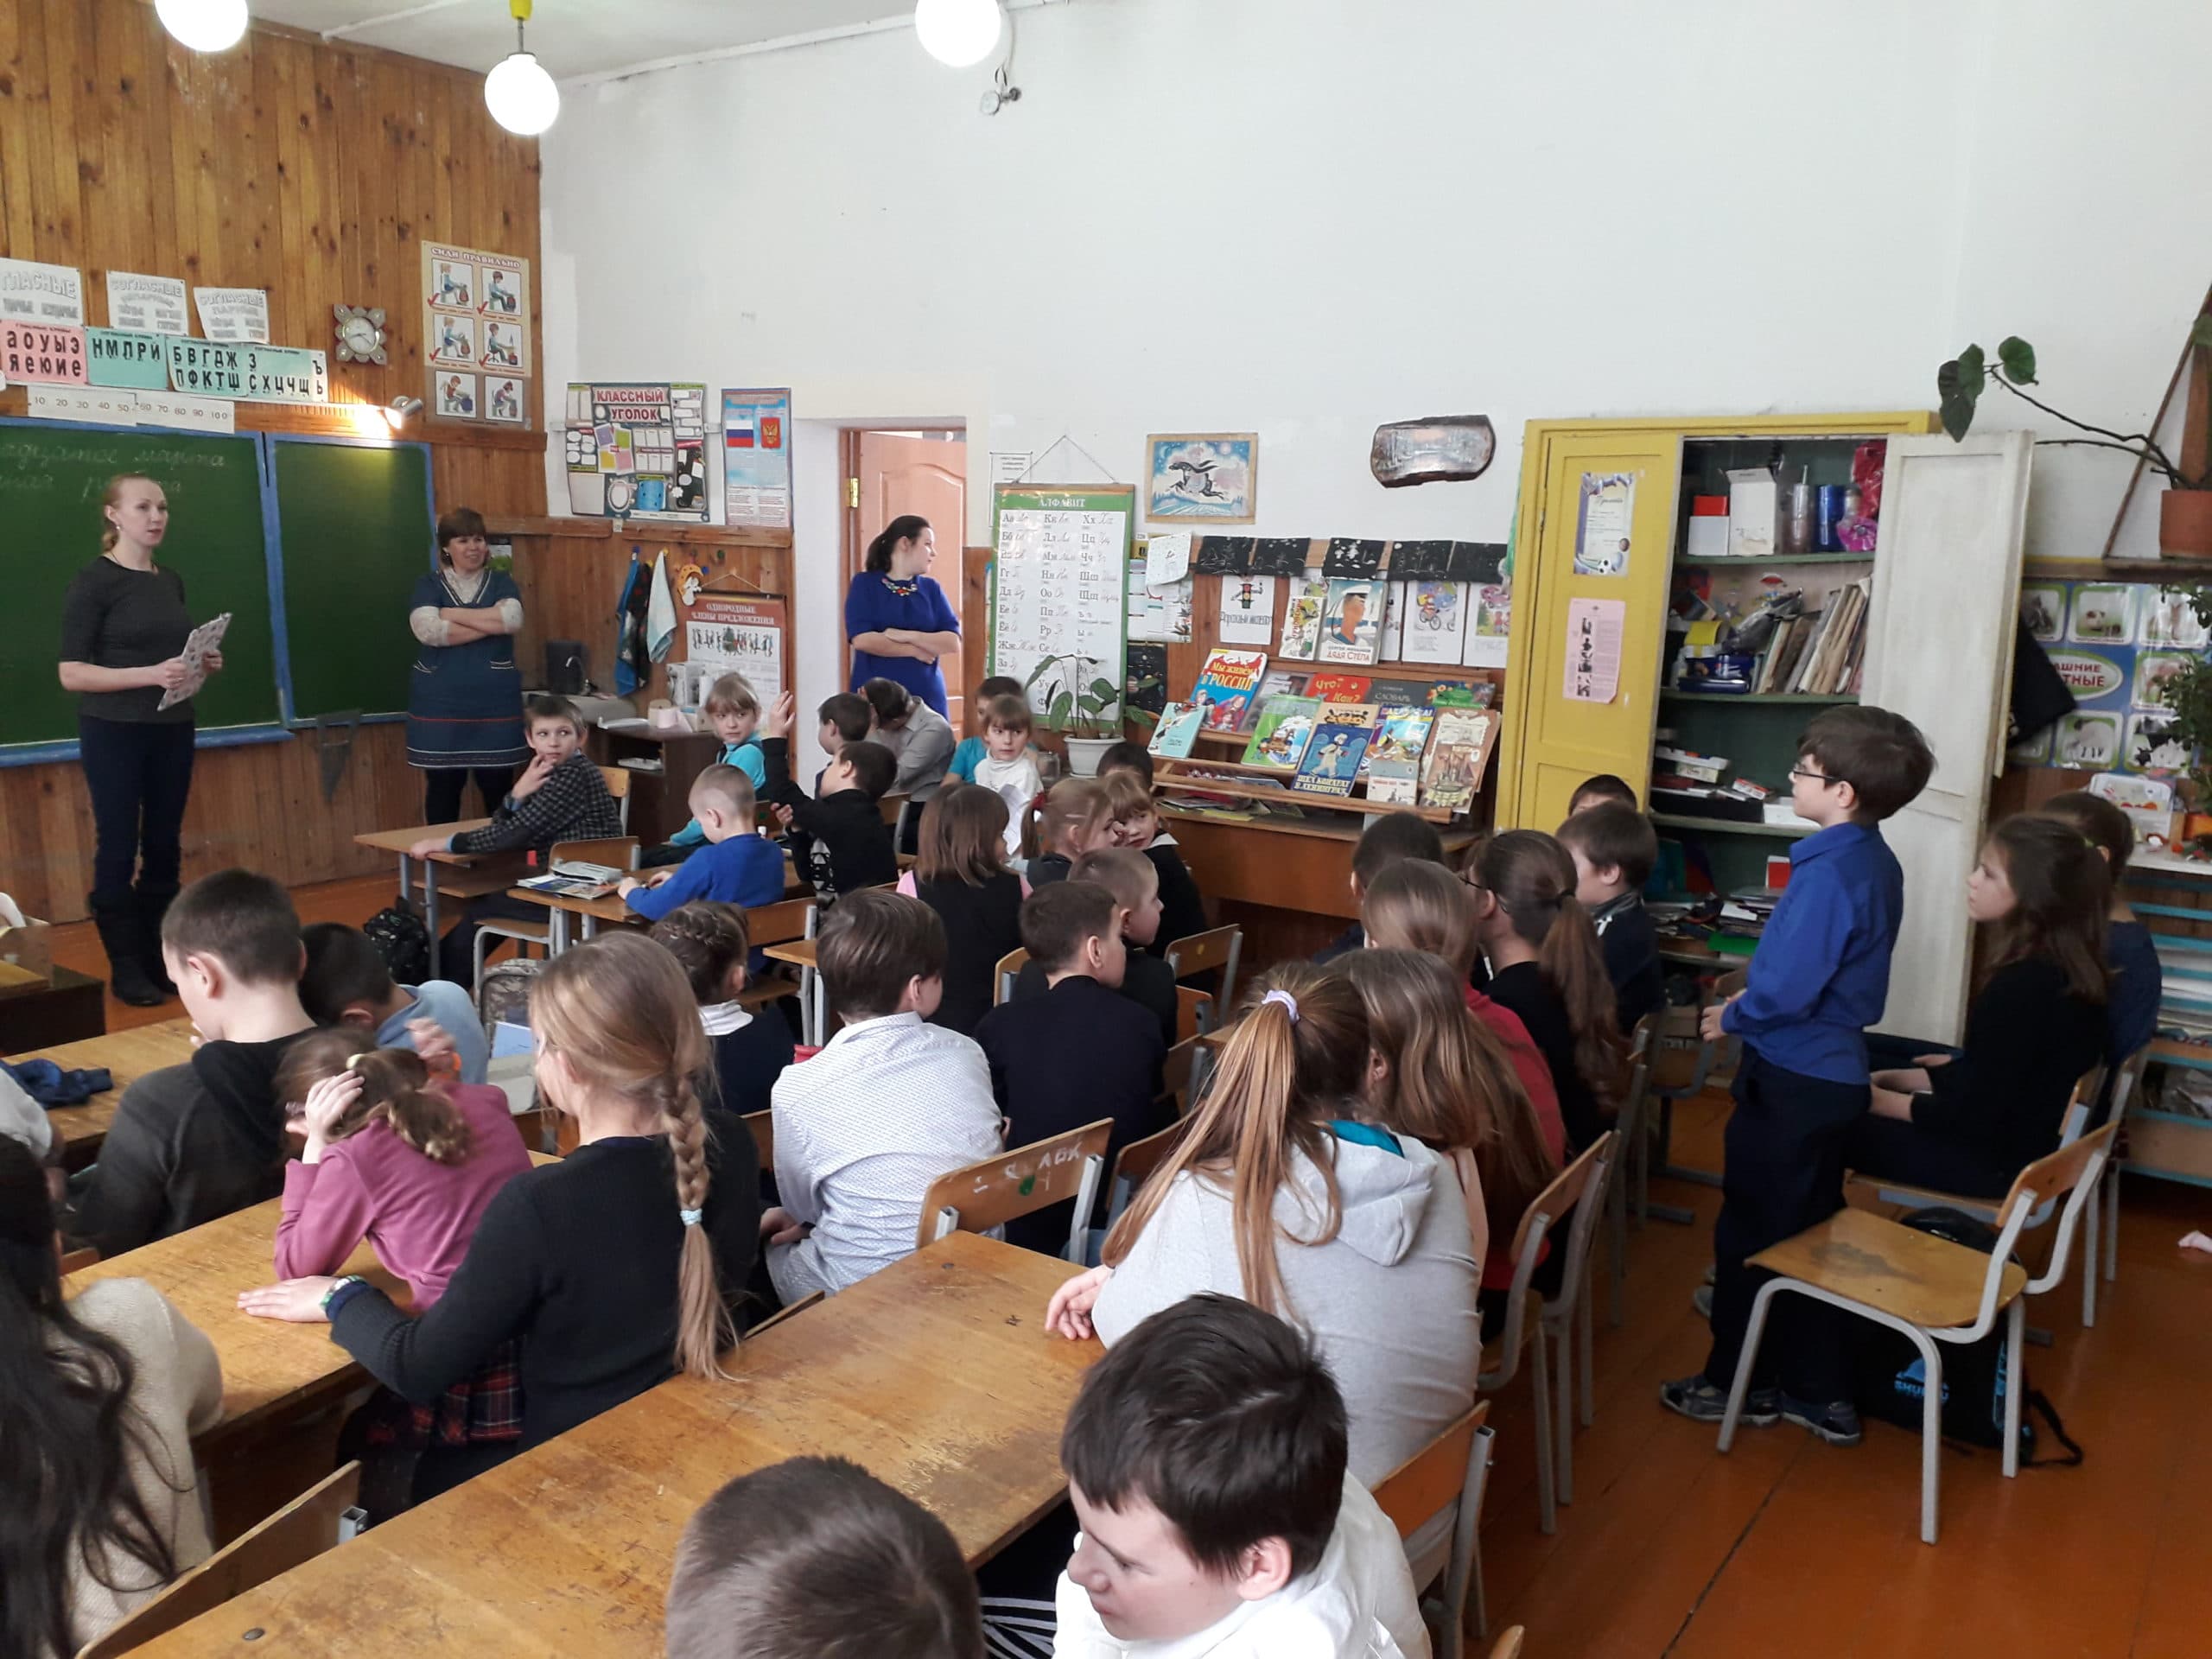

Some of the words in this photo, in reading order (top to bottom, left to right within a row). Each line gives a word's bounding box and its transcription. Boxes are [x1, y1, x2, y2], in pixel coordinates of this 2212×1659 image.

[596, 388, 664, 403] КЛАССНЫЙ
[35, 396, 46, 405] 10
[55, 397, 68, 407] 20
[98, 401, 110, 410] 40
[118, 404, 129, 412] 50
[158, 404, 168, 413] 70
[611, 407, 658, 421] УГОЛОК
[1039, 498, 1086, 508] АЛФАВИТ
[2055, 663, 2101, 673] АШНИЕ
[1209, 673, 1254, 691] РОССИИ
[2063, 674, 2105, 687] ТНЫЕ
